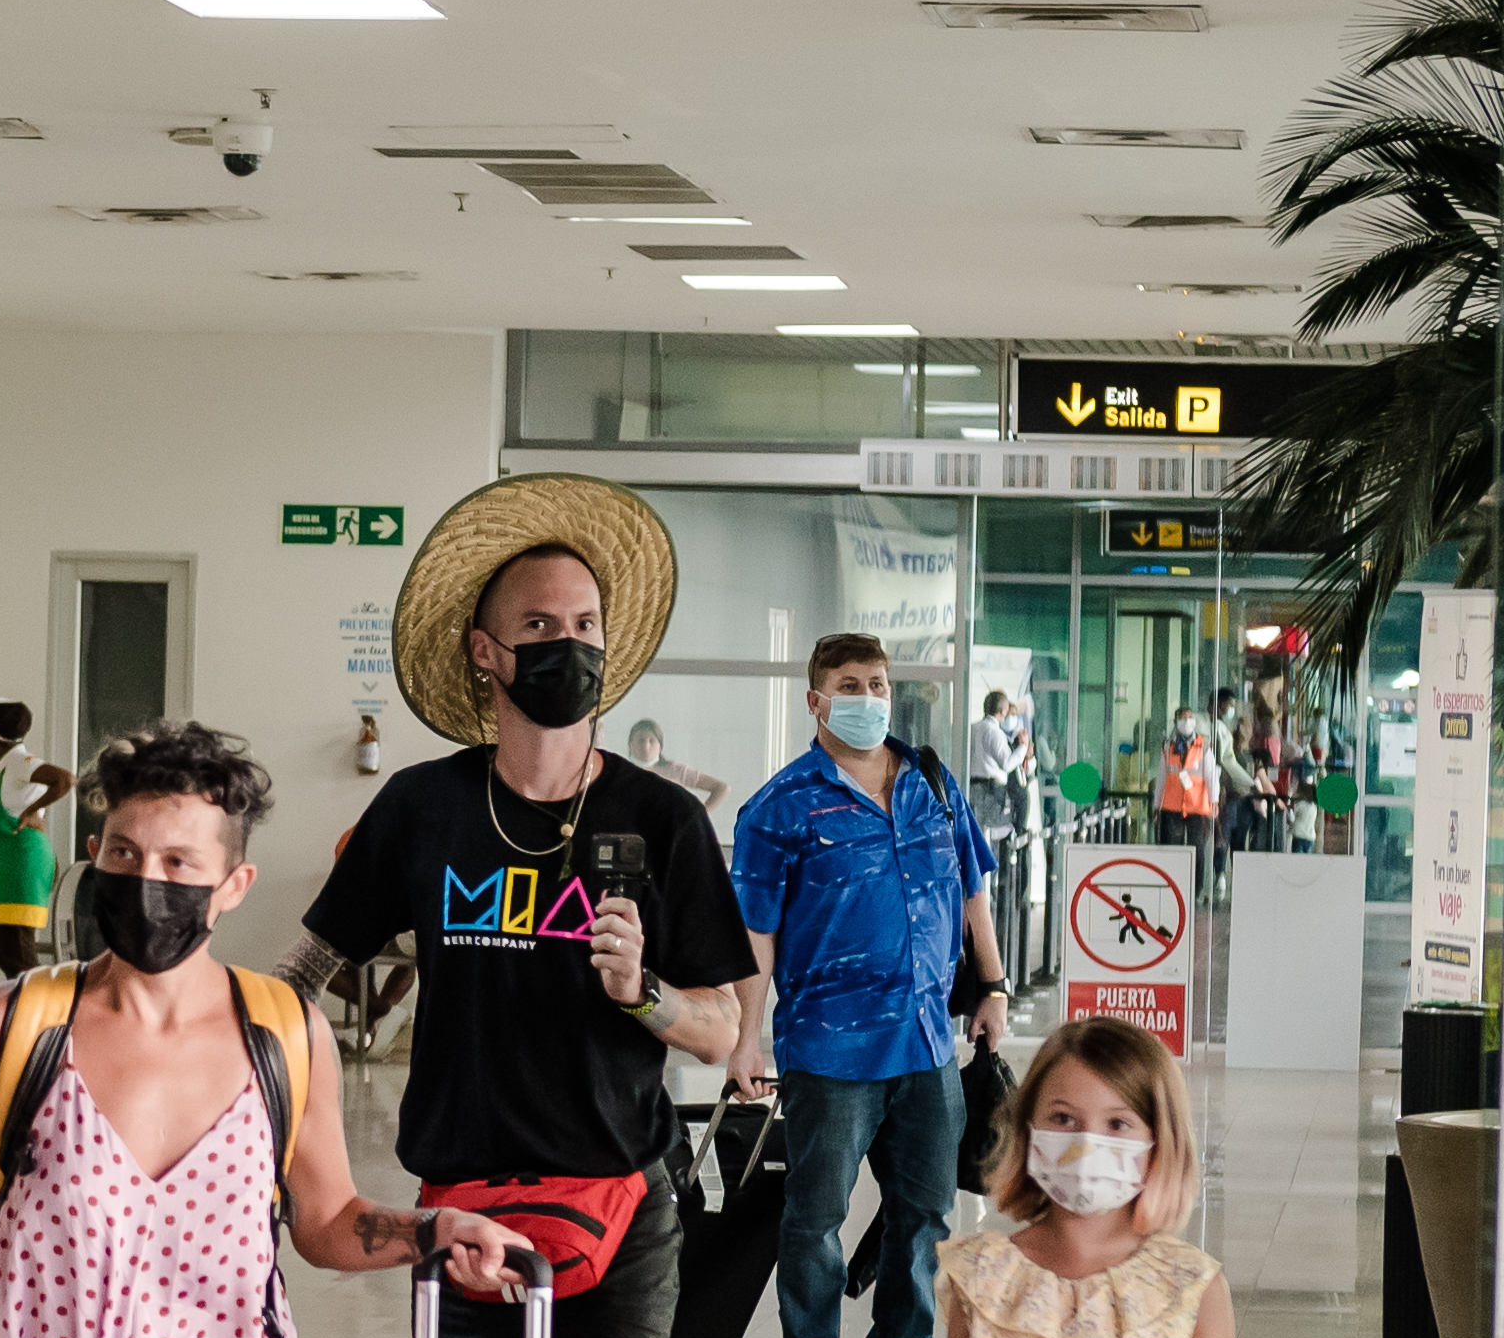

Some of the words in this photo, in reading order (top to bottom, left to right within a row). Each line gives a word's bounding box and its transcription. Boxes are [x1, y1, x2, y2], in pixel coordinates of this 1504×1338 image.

[1105, 386, 1138, 406] Exit
[1105, 406, 1167, 429] Salida
[1188, 395, 1210, 423] P
[339, 619, 393, 631] PREVENCI
[1096, 986, 1157, 1009] PUERTA
